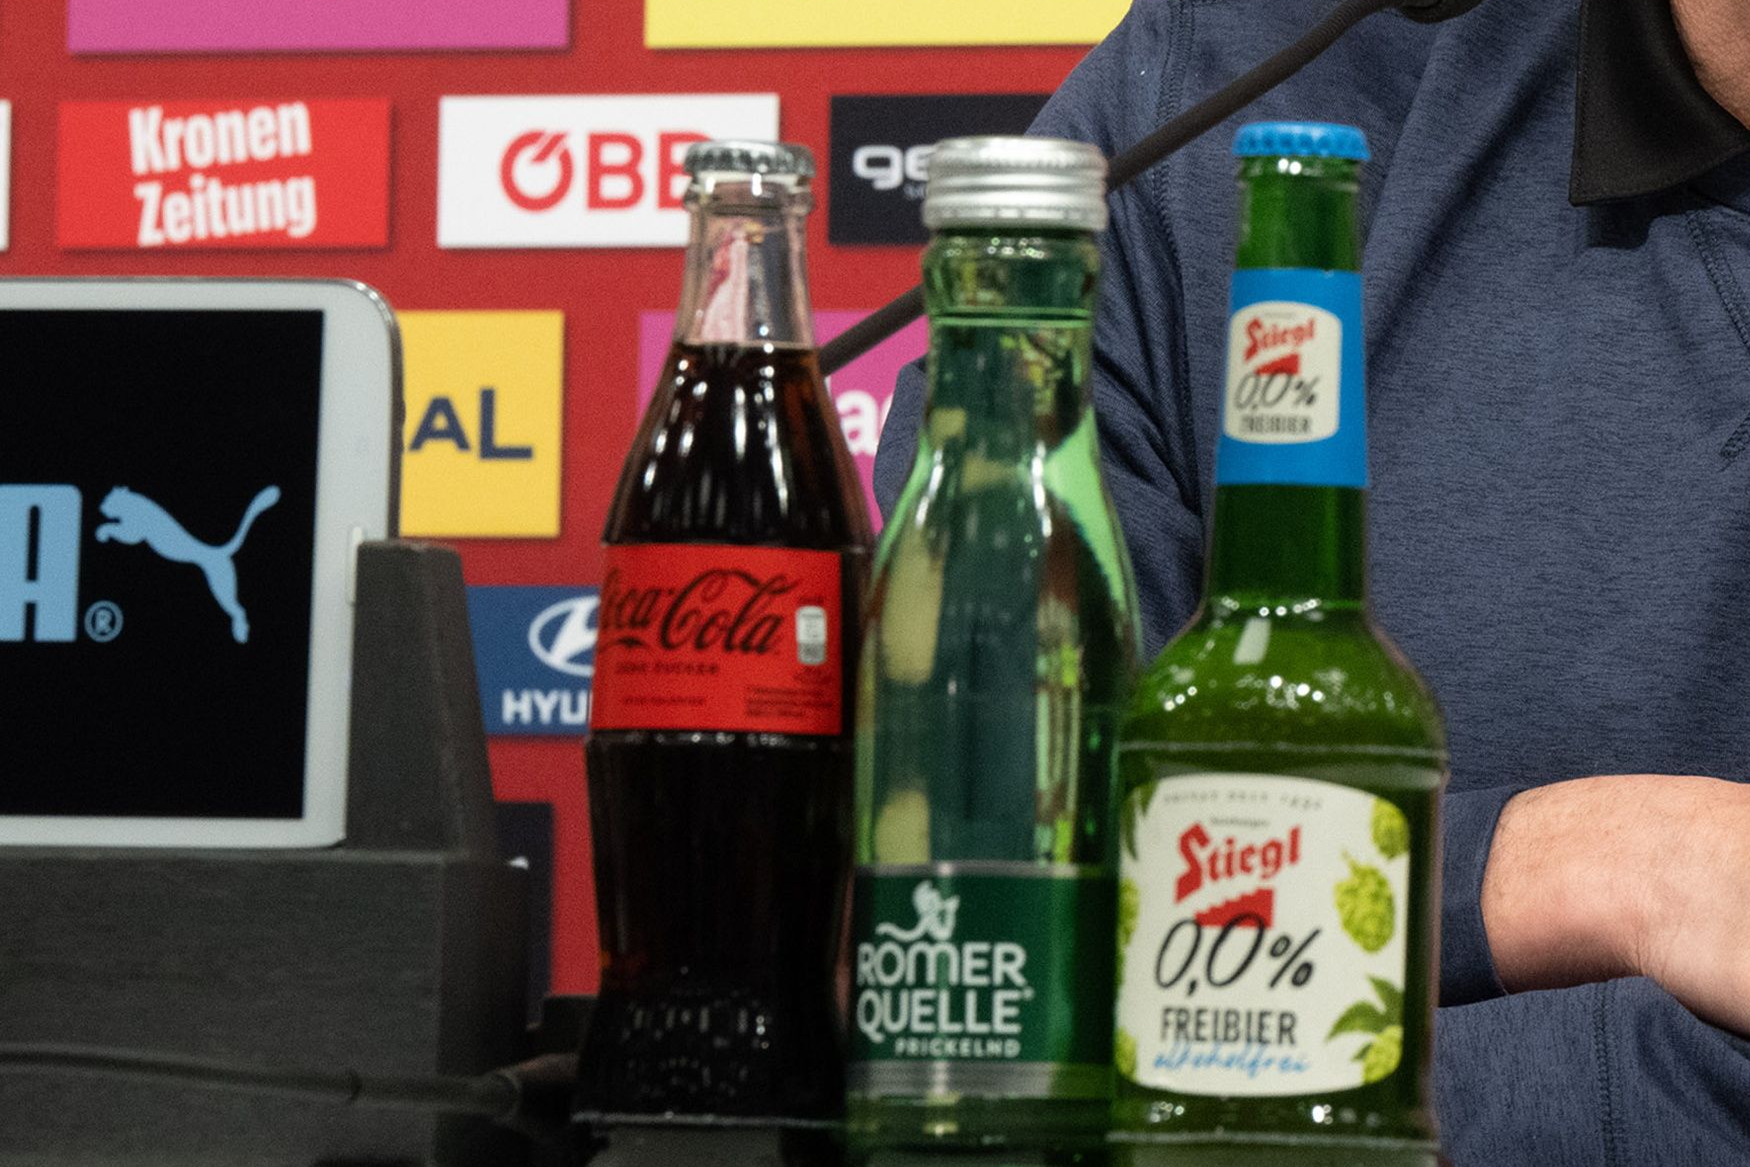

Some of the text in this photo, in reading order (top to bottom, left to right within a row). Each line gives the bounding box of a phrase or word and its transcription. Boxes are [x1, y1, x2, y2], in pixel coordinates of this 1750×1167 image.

[128, 102, 311, 176] Kronen
[133, 174, 317, 249] Zeitung
[1244, 317, 1315, 362] Stiegl
[1174, 821, 1302, 904] Stiegl
[1155, 912, 1323, 996] 0,0%
[857, 989, 1021, 1044] QUELLE
[894, 1037, 1020, 1058] PRICKELND
[1160, 1006, 1297, 1046] FREIBIER
